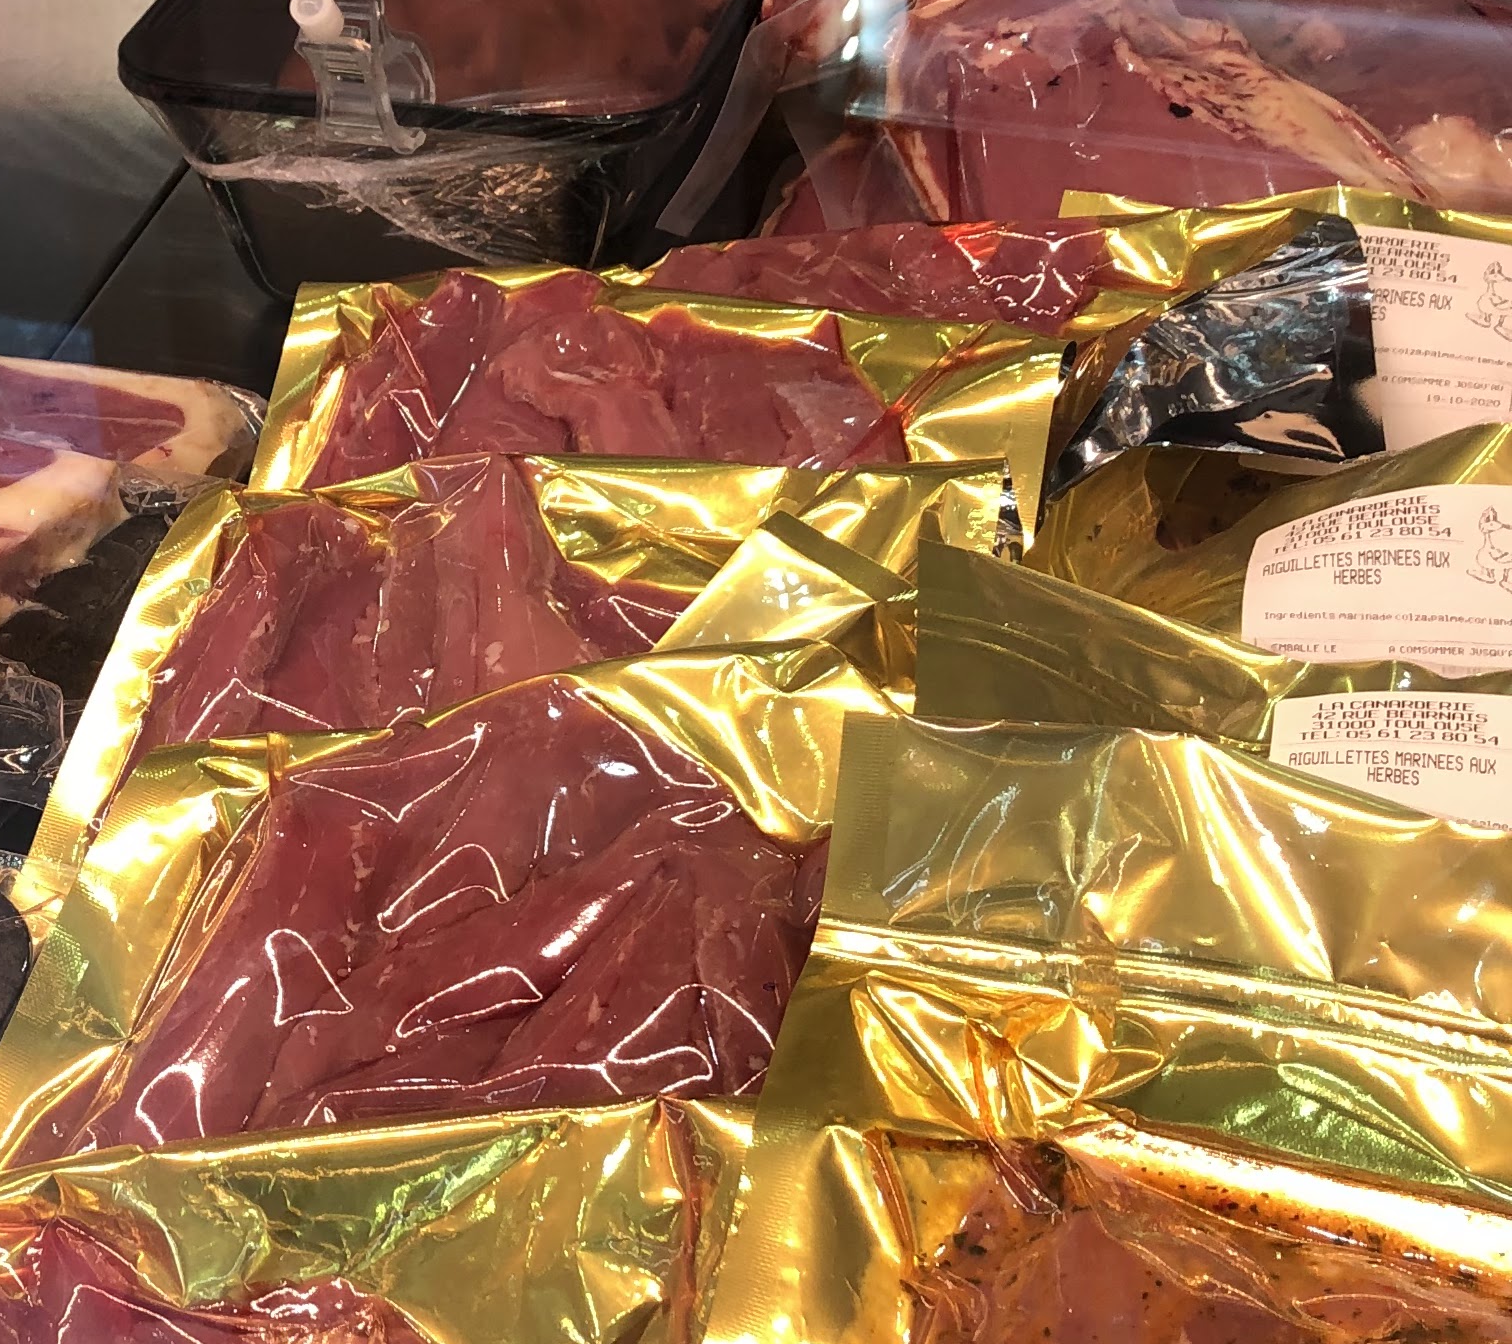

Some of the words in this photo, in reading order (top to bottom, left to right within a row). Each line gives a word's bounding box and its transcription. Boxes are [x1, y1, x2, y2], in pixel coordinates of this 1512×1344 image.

[1360, 235, 1441, 251] NARDERIE
[1365, 246, 1452, 263] BEARNAIS
[1368, 256, 1444, 271] OULOUSE
[1408, 269, 1432, 281] 80
[1436, 272, 1458, 284] 54
[1428, 293, 1453, 311] AUX
[1426, 394, 1501, 408] 19-10-2020
[1318, 495, 1428, 523] CANARDERIE
[1348, 504, 1441, 523] BEARNAIS
[1348, 515, 1441, 532] TOULOUSE
[1313, 535, 1336, 545] 05
[1340, 530, 1363, 541] 61
[1369, 527, 1394, 538] 23
[1399, 526, 1423, 537] 80
[1428, 527, 1452, 538] 54
[1262, 551, 1353, 576] AIGUILLETTES
[1357, 549, 1421, 567] MARINEES
[1425, 550, 1451, 568] AUX
[1333, 568, 1382, 585] HERBES
[1324, 644, 1337, 653] LE
[1388, 645, 1396, 654] A
[1319, 702, 1345, 712] LA
[1350, 700, 1475, 712] CANARDERIE
[1312, 711, 1336, 720] 42
[1342, 710, 1380, 720] RUE
[1386, 710, 1488, 724] BEARNAIS
[1312, 720, 1376, 730] 31000
[1385, 719, 1485, 734] TOULOUSE
[1299, 730, 1341, 741] TEL:
[1346, 729, 1372, 740] 05
[1377, 729, 1401, 740] 61
[1410, 730, 1435, 741] 23
[1442, 732, 1468, 743] 80
[1474, 734, 1500, 747] 54
[1288, 749, 1390, 767] AIGUILLETTES
[1394, 751, 1464, 772] MARINEES
[1469, 757, 1497, 775] AUX
[1367, 767, 1420, 786] HERBES
